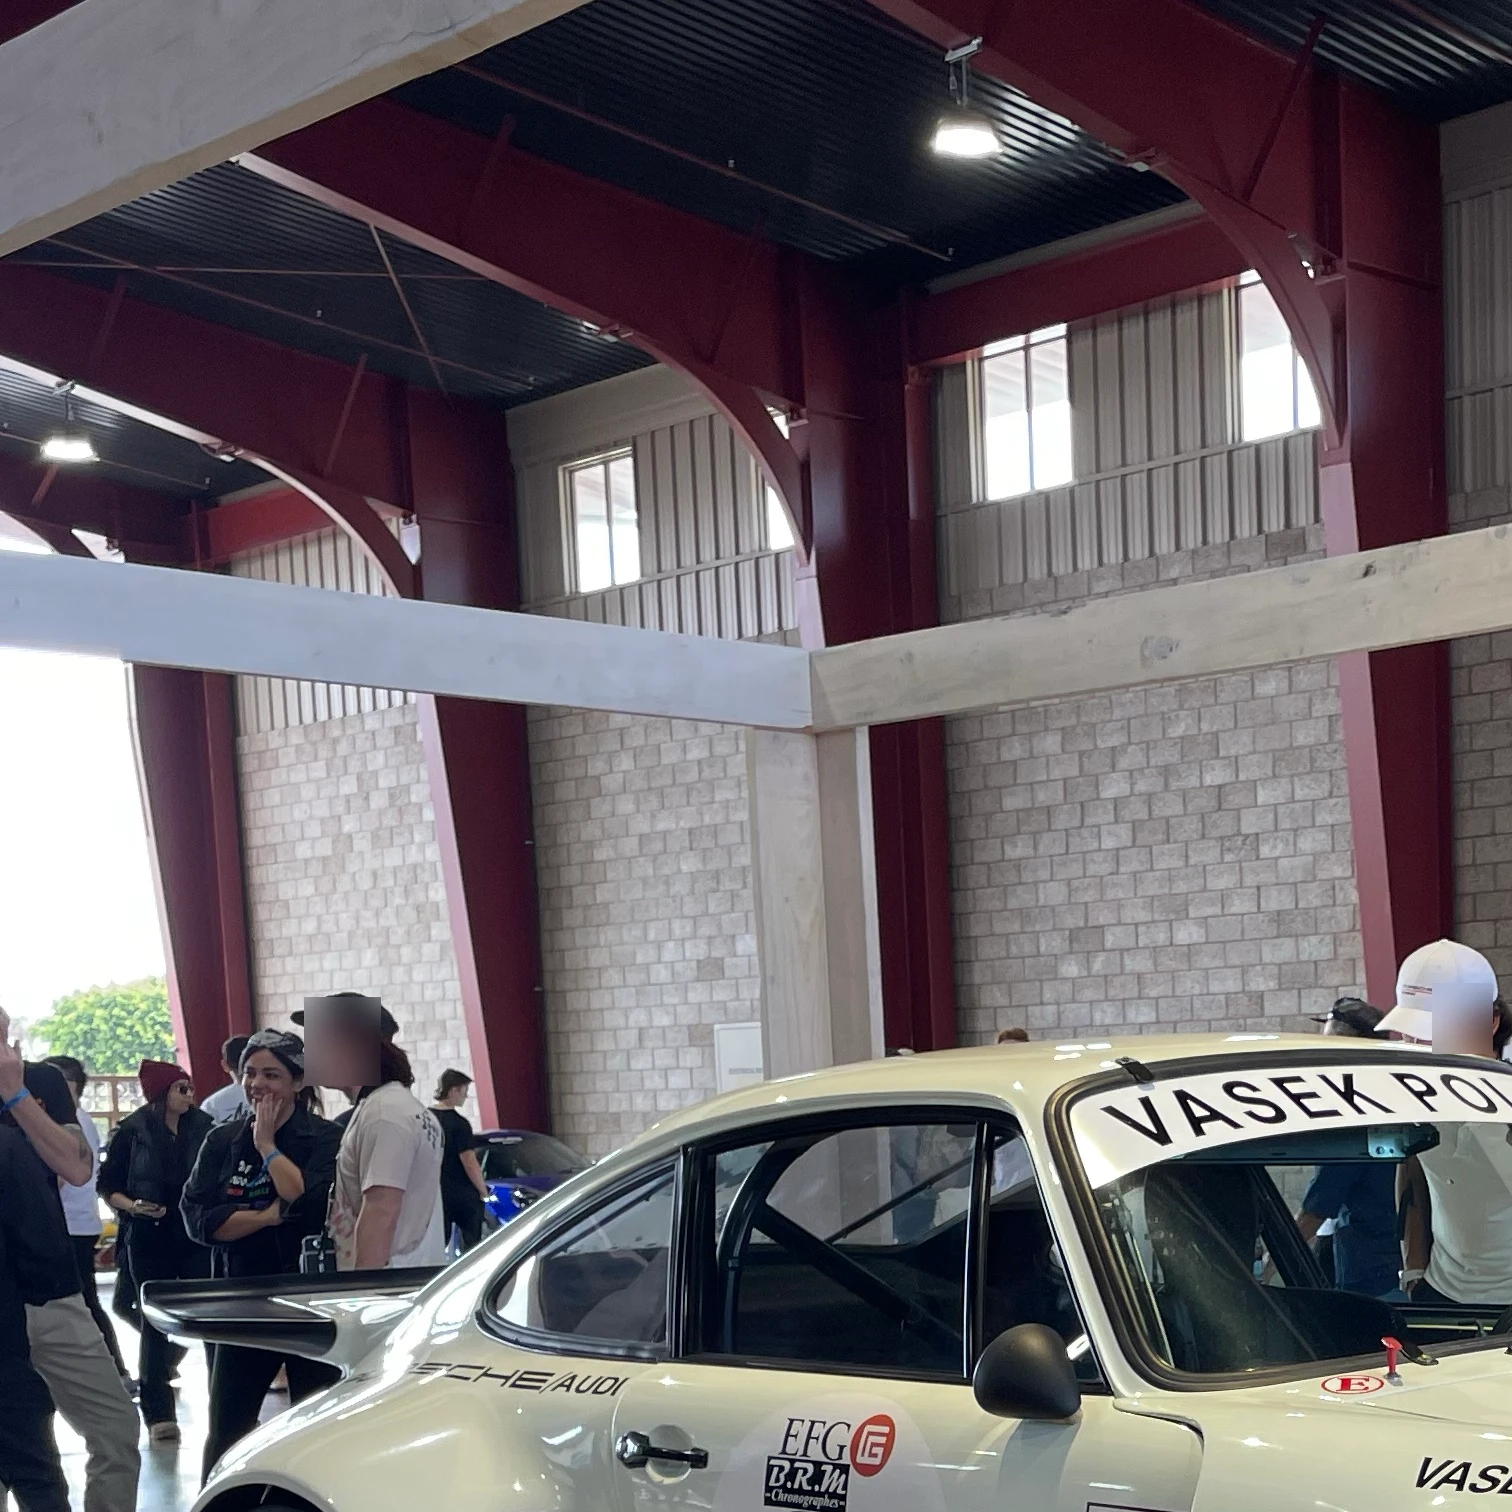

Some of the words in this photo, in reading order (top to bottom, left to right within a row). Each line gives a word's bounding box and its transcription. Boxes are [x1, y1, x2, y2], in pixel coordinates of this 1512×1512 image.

[1100, 1072, 1396, 1147] VASEK
[1336, 1377, 1370, 1391] E
[778, 1417, 851, 1461] EFG
